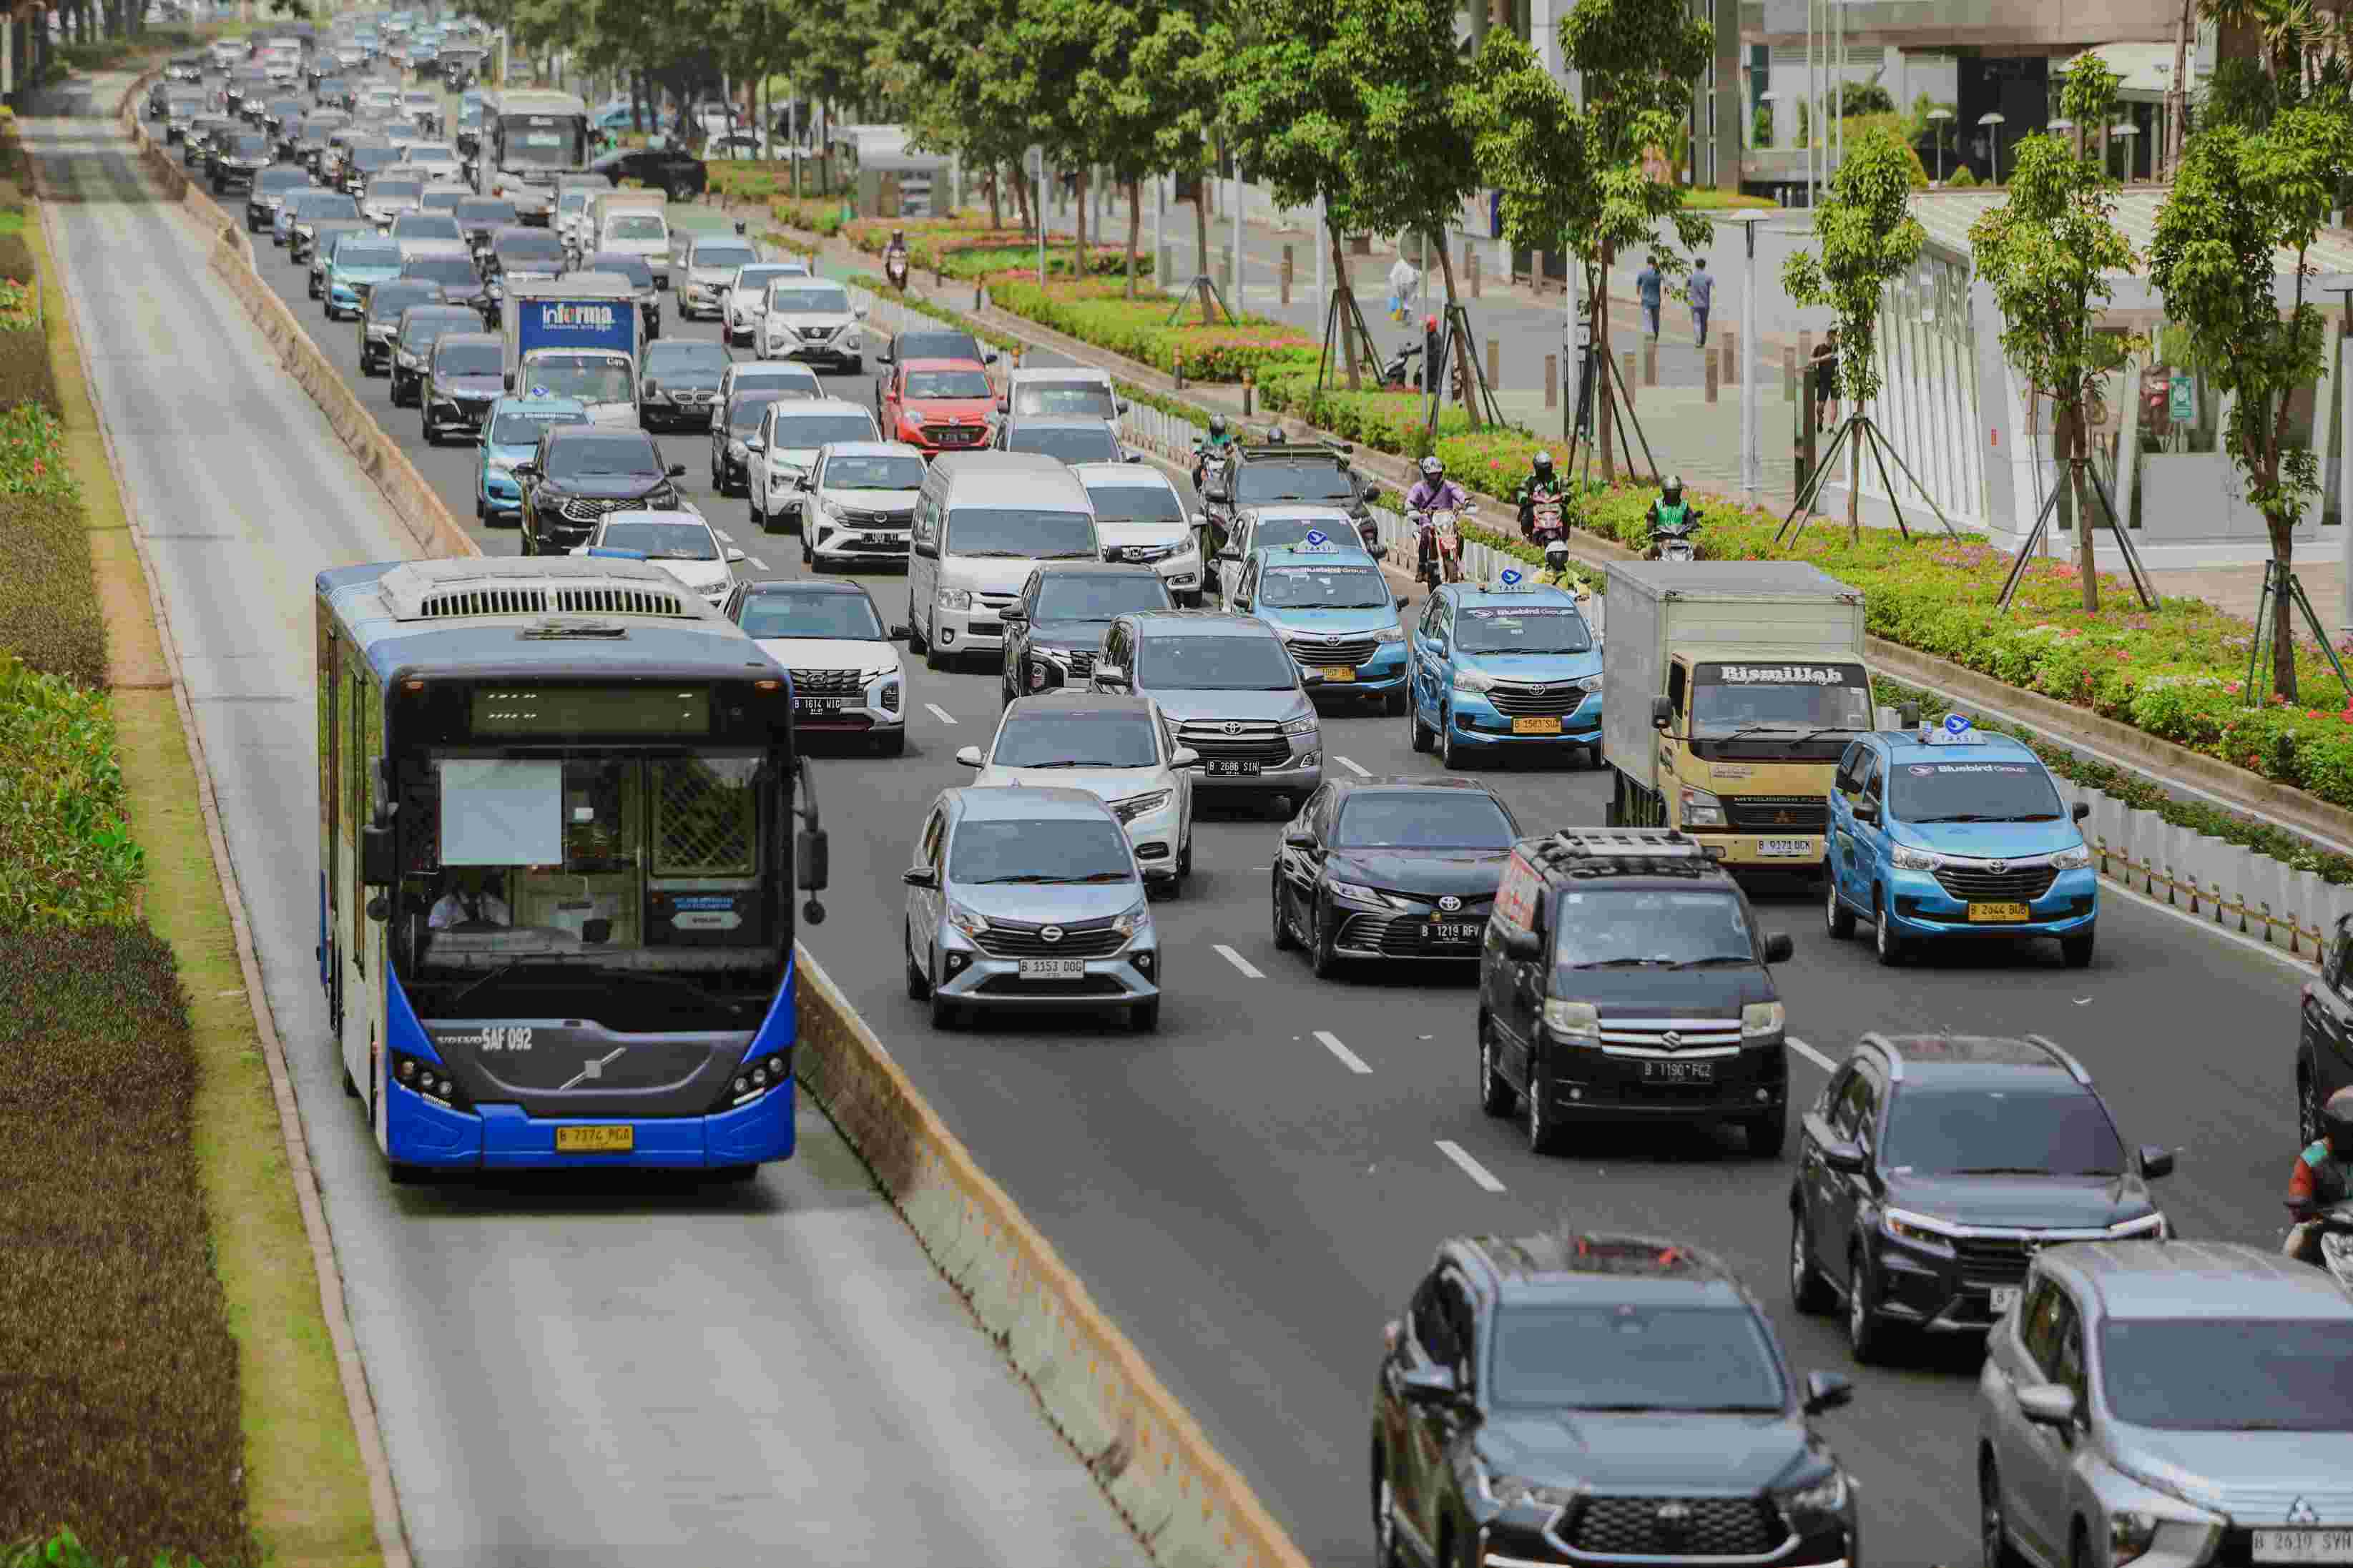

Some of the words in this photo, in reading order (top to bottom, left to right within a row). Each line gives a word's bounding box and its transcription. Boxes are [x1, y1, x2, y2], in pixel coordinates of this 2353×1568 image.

[1721, 666, 1842, 685] Bismillah
[795, 699, 800, 709] B
[1209, 761, 1214, 771] B
[1937, 764, 1993, 773] Bluebird
[1422, 925, 1429, 937] B
[1021, 960, 1028, 972] B
[1033, 960, 1059, 972] 1153
[481, 1027, 504, 1050] SAF
[507, 1027, 533, 1050] 092
